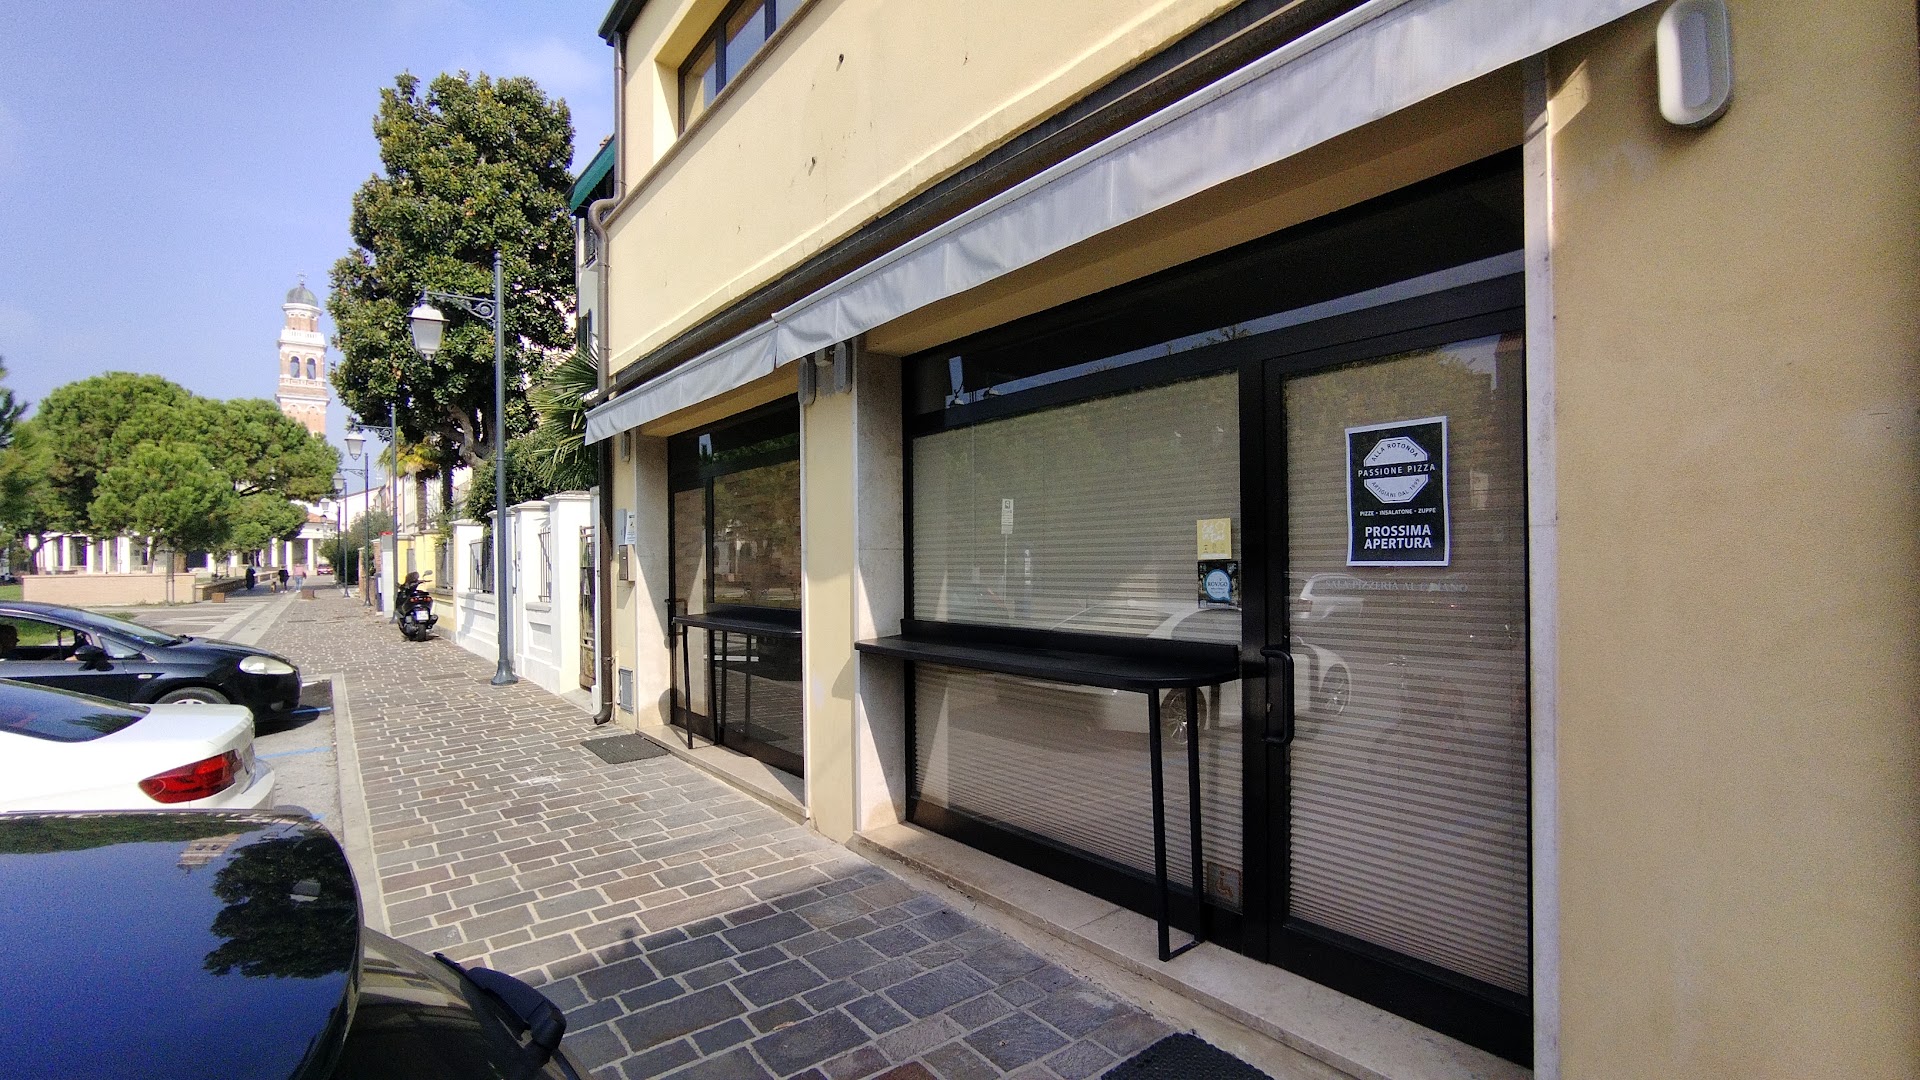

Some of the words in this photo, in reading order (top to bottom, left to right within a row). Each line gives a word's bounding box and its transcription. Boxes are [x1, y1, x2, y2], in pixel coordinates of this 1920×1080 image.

[1371, 447, 1385, 462] ALLA
[1387, 442, 1419, 458] ROTONDA
[1357, 466, 1403, 478] PASSIONE
[1407, 463, 1436, 473] PIZZA
[1371, 481, 1397, 498] ARTIGIANI
[1397, 489, 1410, 498] DAL
[1379, 508, 1413, 516] INSALATONE
[1364, 524, 1432, 538] PROSSIMA
[1363, 537, 1432, 550] APERTURA
